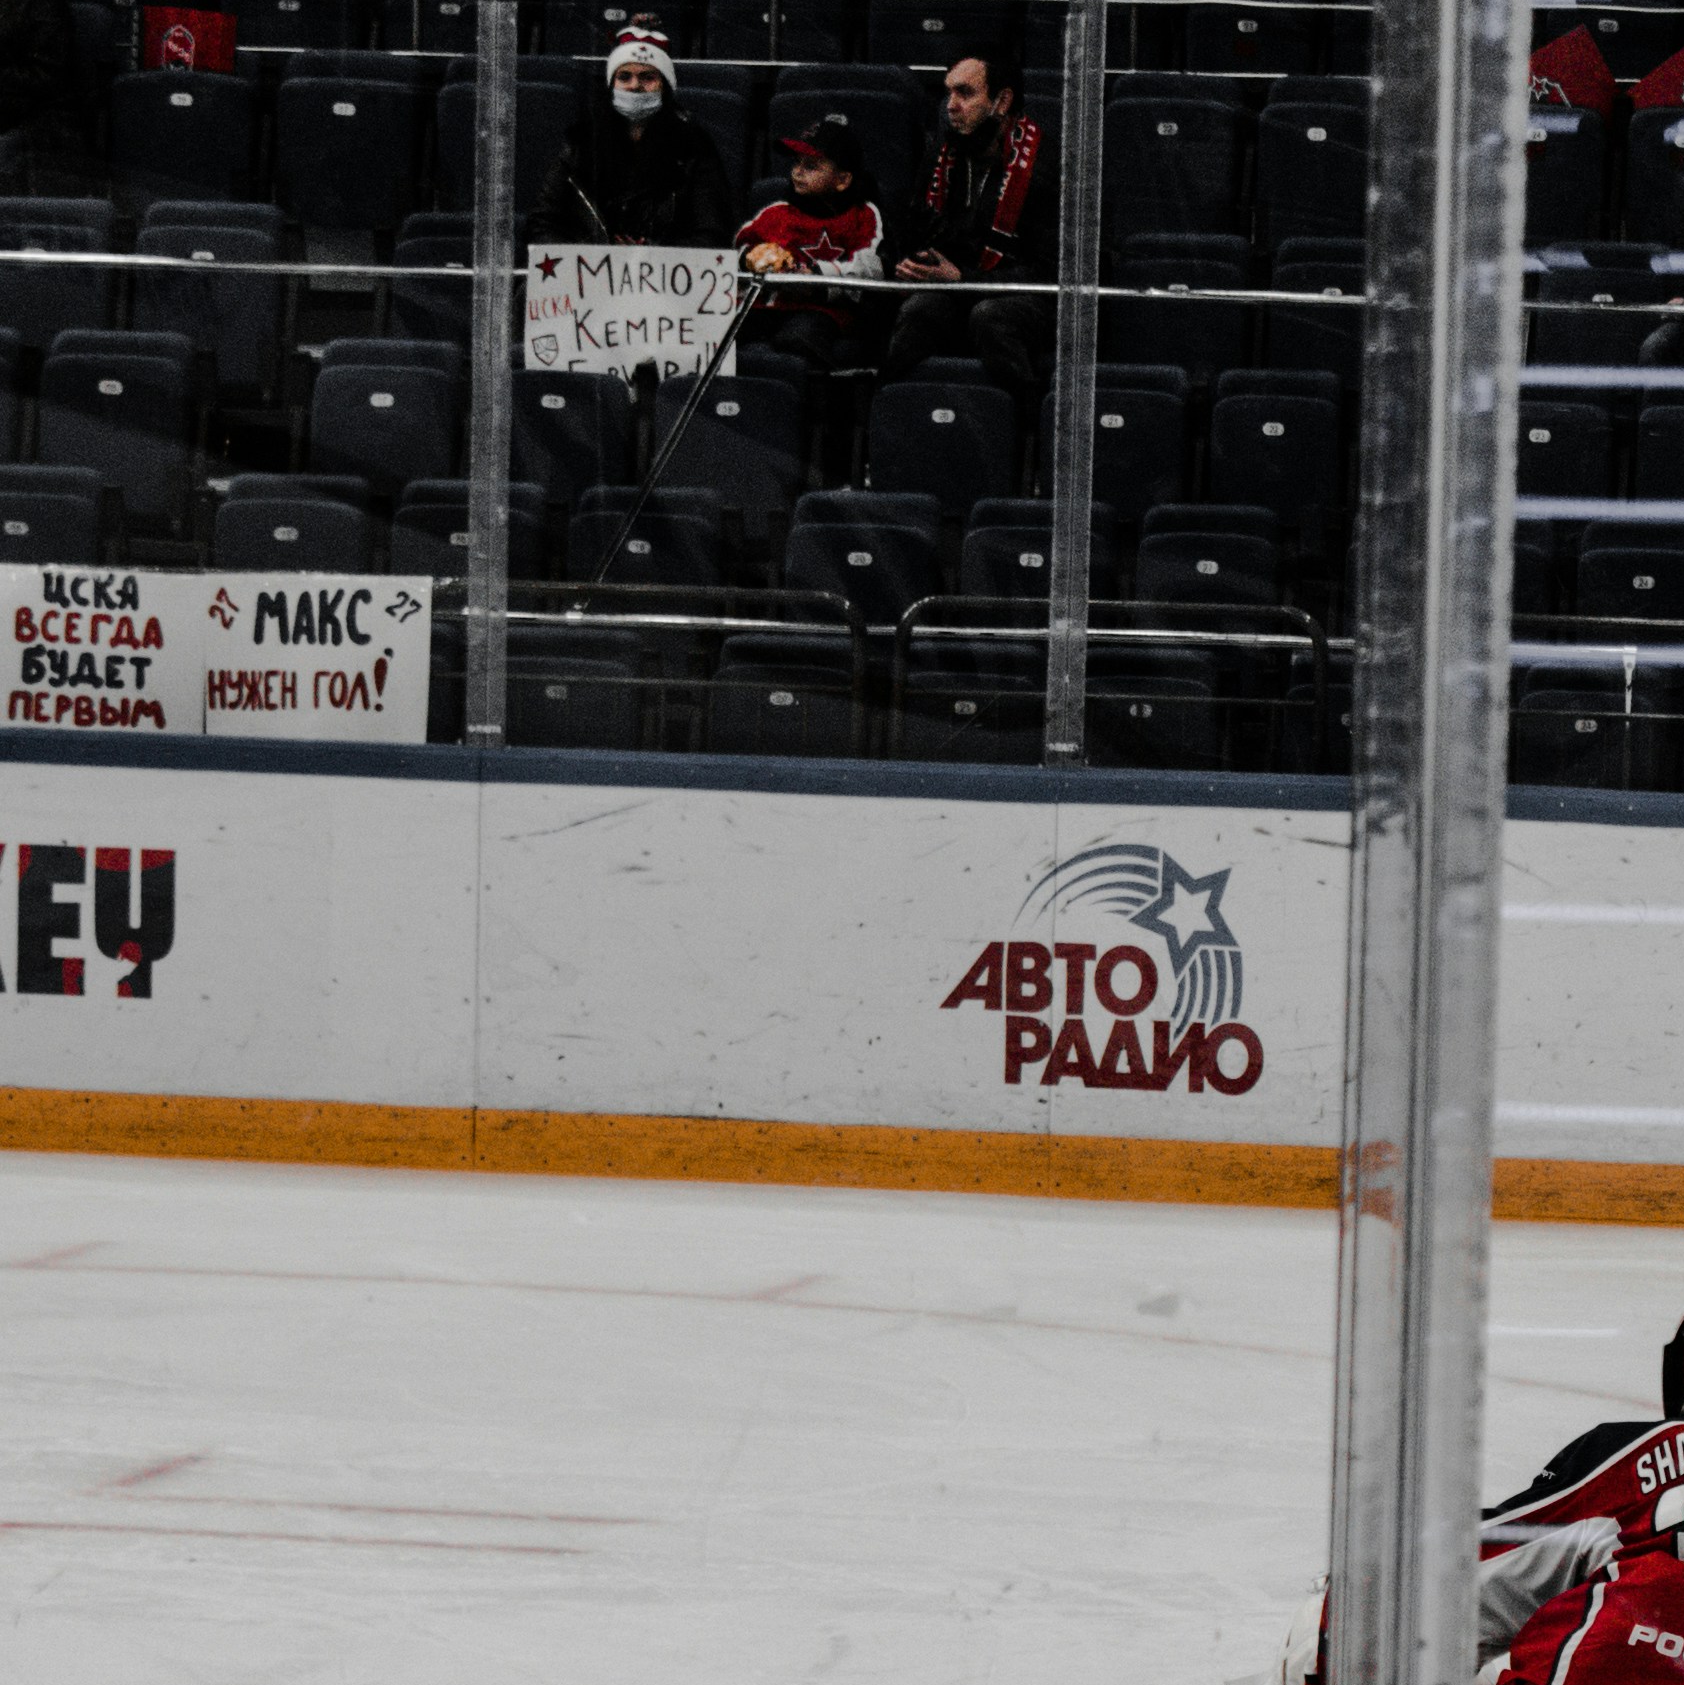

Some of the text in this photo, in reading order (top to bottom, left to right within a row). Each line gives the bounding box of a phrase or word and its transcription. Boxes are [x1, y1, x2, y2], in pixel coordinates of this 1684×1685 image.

[577, 254, 735, 316] MARIO 23
[528, 294, 573, 321] ЦСКА
[573, 308, 695, 352] KEMPE
[43, 572, 140, 611] ЦСКА
[208, 587, 240, 630] 27
[385, 591, 422, 623] 27
[14, 606, 164, 649] ВСЕГДА
[253, 589, 372, 645] МАКС
[21, 644, 152, 689] БУДЕТ
[208, 656, 389, 712] НУЖЕН ГОЛ!
[8, 690, 166, 729] ПЕРВЫМ
[0, 844, 175, 999] EY
[939, 941, 1159, 1016] АВТО
[1005, 1015, 1264, 1096] РАДИО
